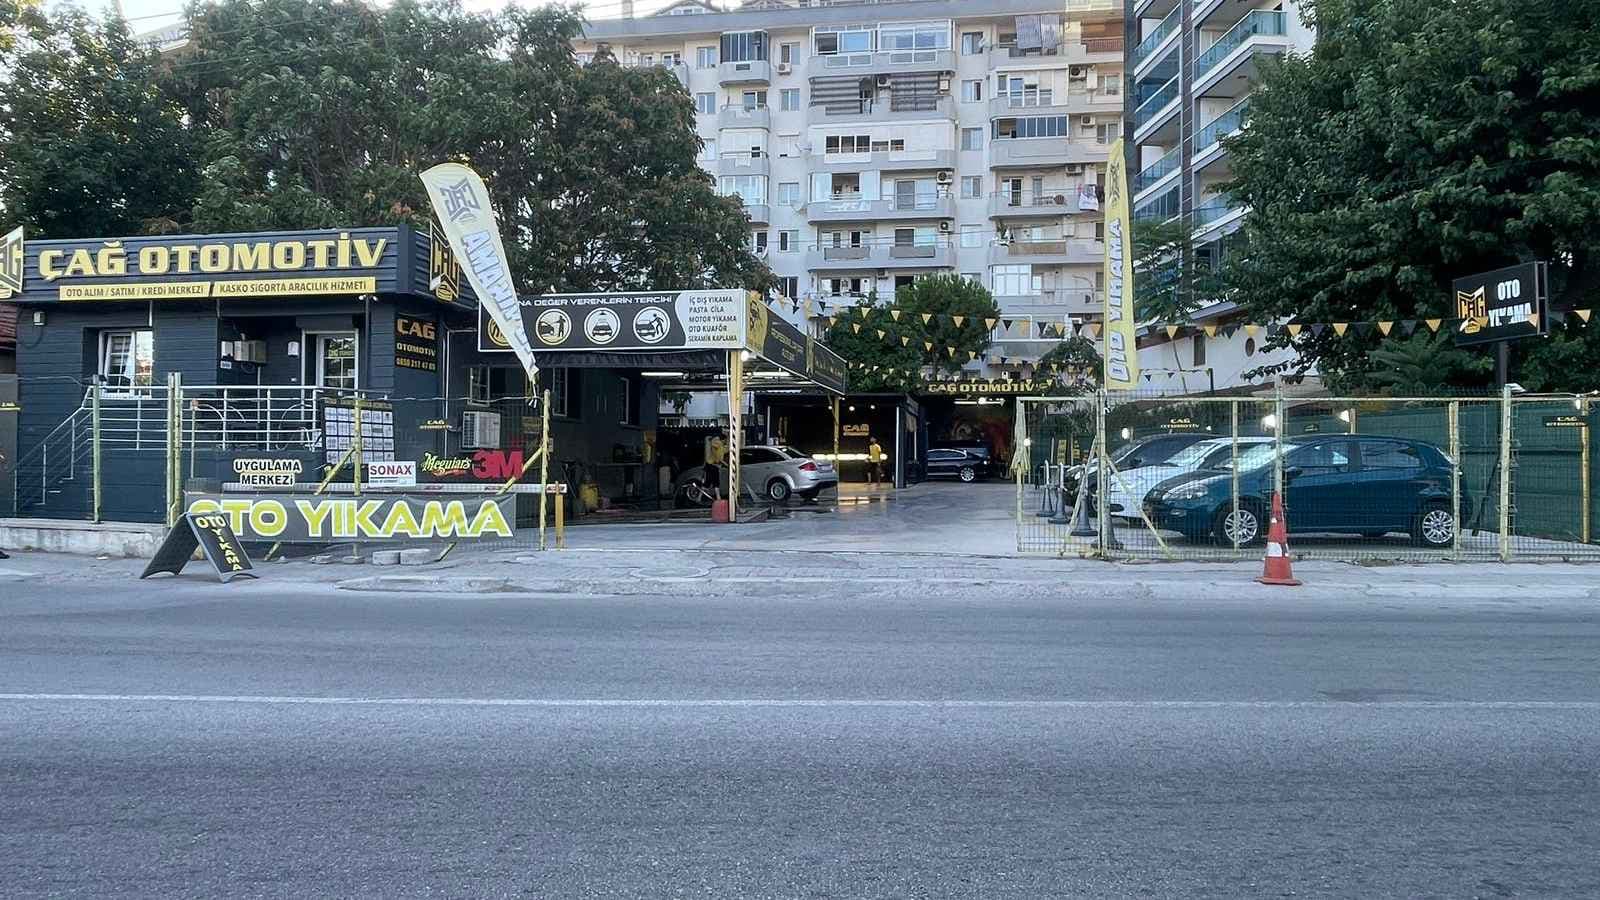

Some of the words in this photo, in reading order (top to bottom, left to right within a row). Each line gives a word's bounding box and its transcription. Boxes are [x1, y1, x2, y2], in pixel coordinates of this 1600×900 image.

[39, 240, 127, 281] ÇAĞ
[139, 232, 387, 274] OTOMOTİV
[1109, 217, 1124, 321] YIKAMA
[66, 288, 82, 297] OTO
[85, 288, 104, 297] ALIM
[111, 287, 135, 296] SATIM
[220, 283, 248, 293] KASKO
[288, 281, 328, 292] ARACILIK
[1497, 279, 1521, 301] OTO
[708, 296, 733, 304] YIKAMA
[688, 325, 701, 333] OTO
[234, 459, 302, 473] UYGULAMA
[369, 464, 412, 476] SONAX
[471, 450, 523, 479] 3M
[195, 516, 227, 529] OTO
[296, 500, 513, 537] YIKAMA
[211, 528, 244, 571] YIKAMA
